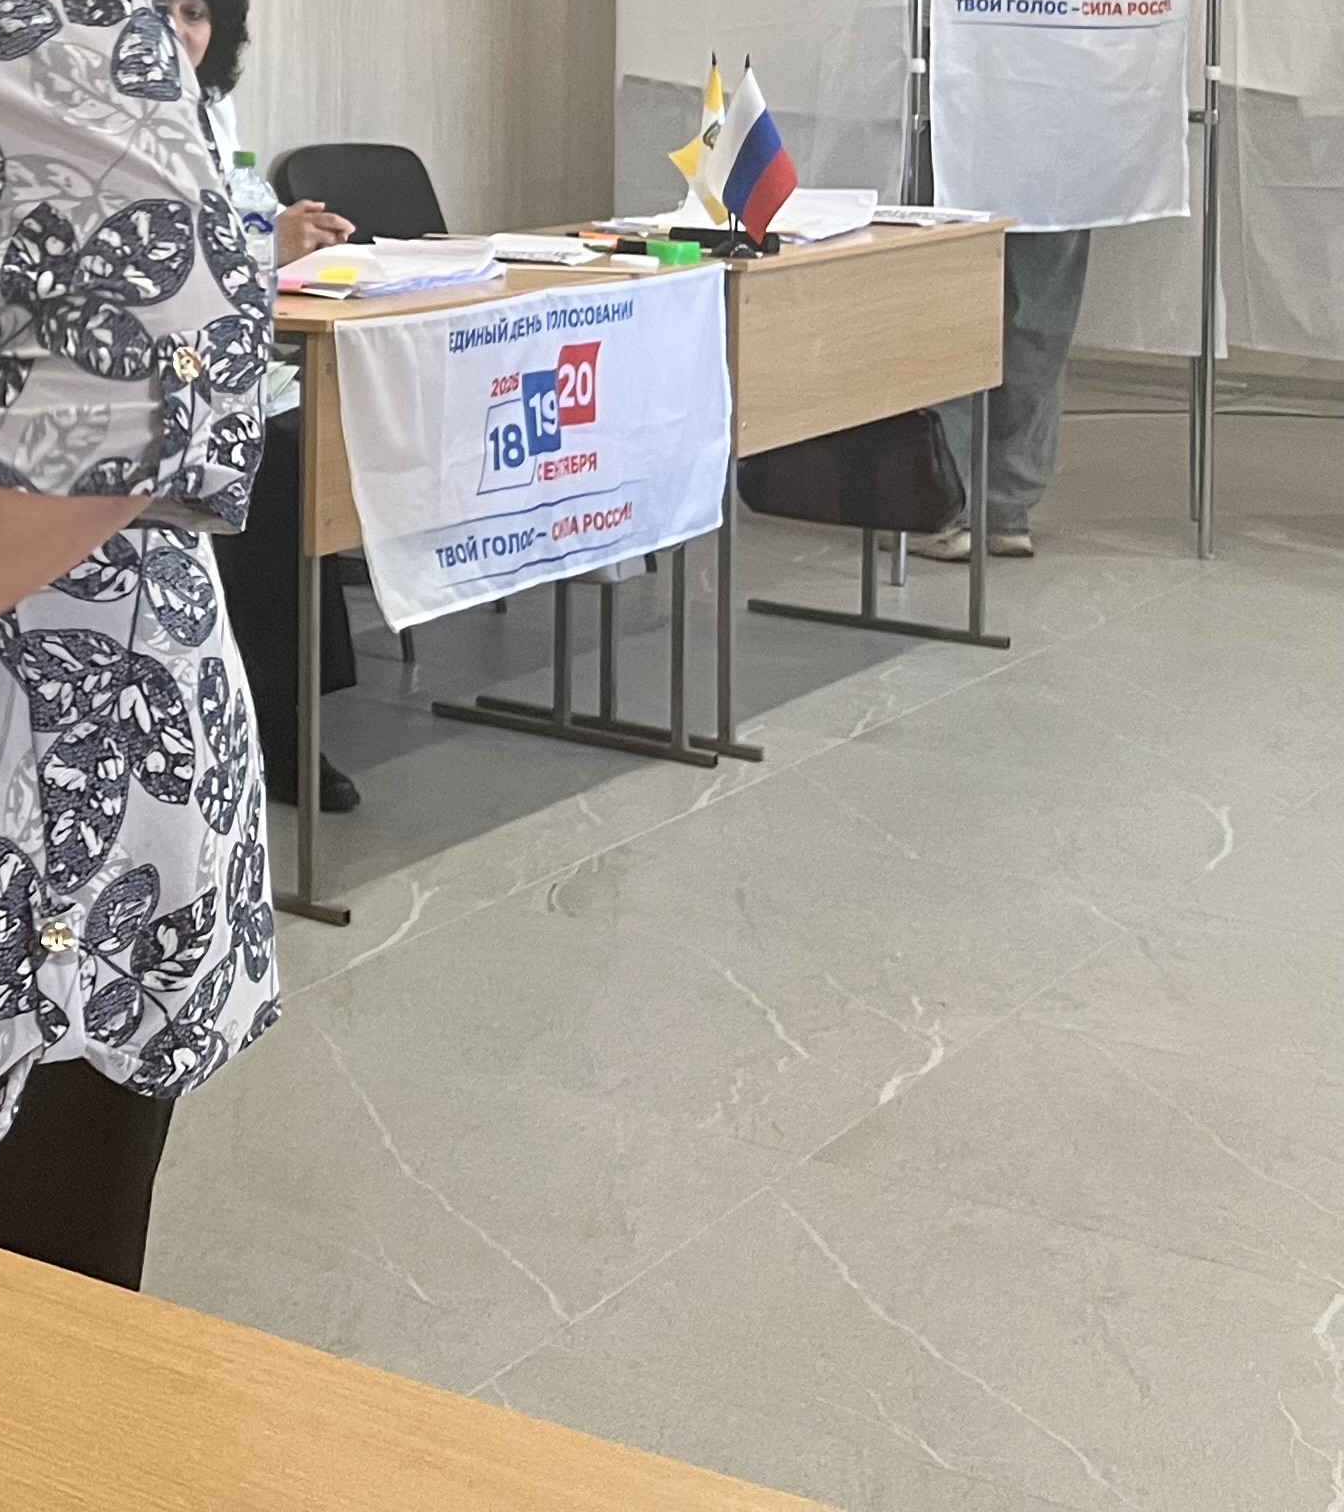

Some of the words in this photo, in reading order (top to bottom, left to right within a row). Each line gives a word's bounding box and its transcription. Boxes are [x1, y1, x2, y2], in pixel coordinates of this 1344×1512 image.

[1082, 1, 1122, 16] СИЛА
[449, 318, 508, 354] ЕДИНЫЙ
[558, 361, 593, 408] 20
[529, 390, 559, 437] 19
[489, 424, 526, 471] 18
[435, 536, 479, 569] ТВОЙ
[482, 528, 536, 559] ГОЛОС
